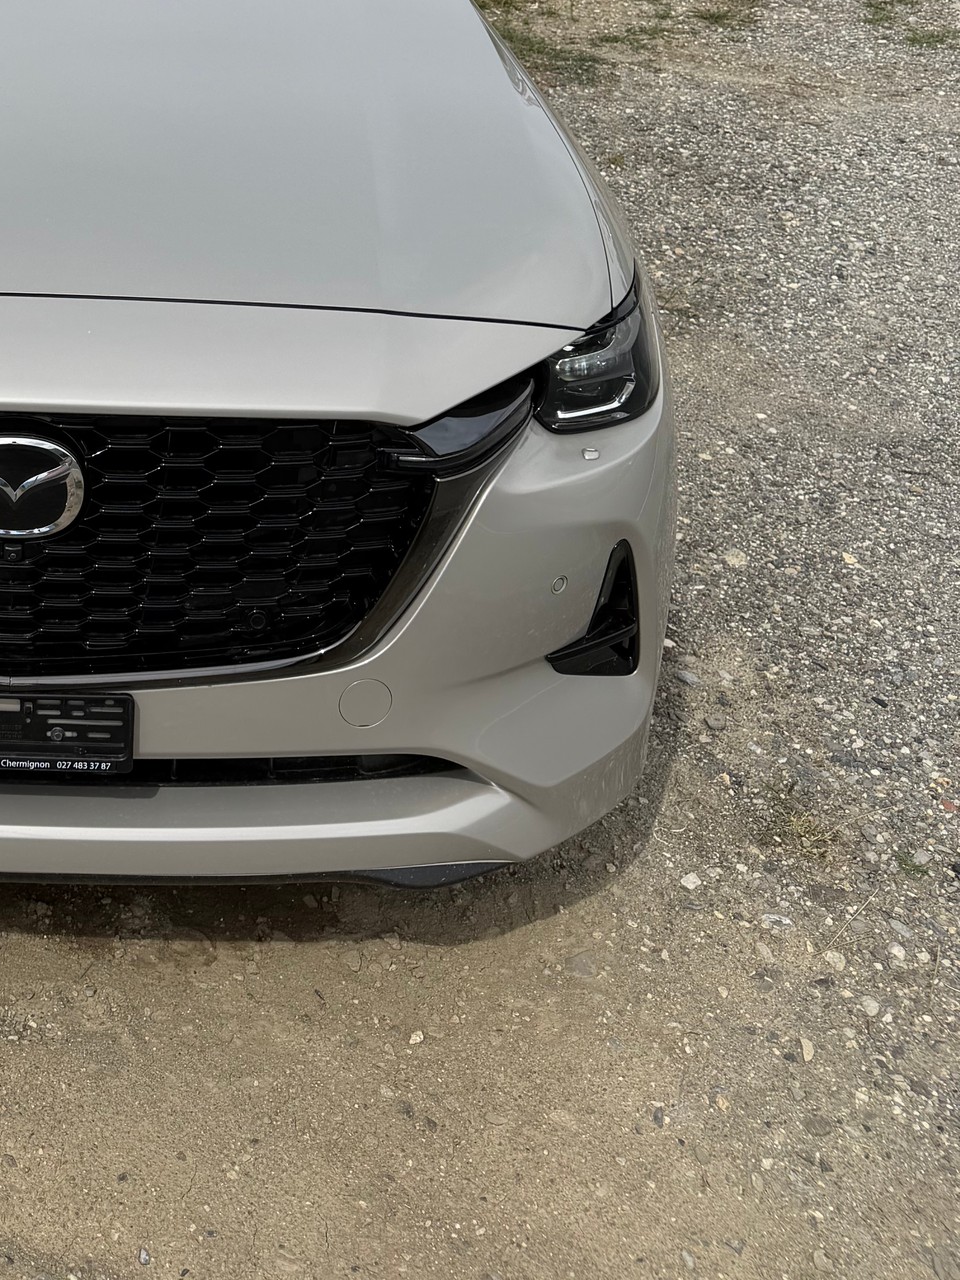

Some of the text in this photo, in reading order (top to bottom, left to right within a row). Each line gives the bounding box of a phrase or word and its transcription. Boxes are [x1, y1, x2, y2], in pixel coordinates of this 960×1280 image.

[0, 759, 50, 769] Chermignon
[56, 761, 72, 769] 027
[73, 762, 88, 770] 483
[89, 762, 100, 770] 37
[100, 762, 111, 770] 87
